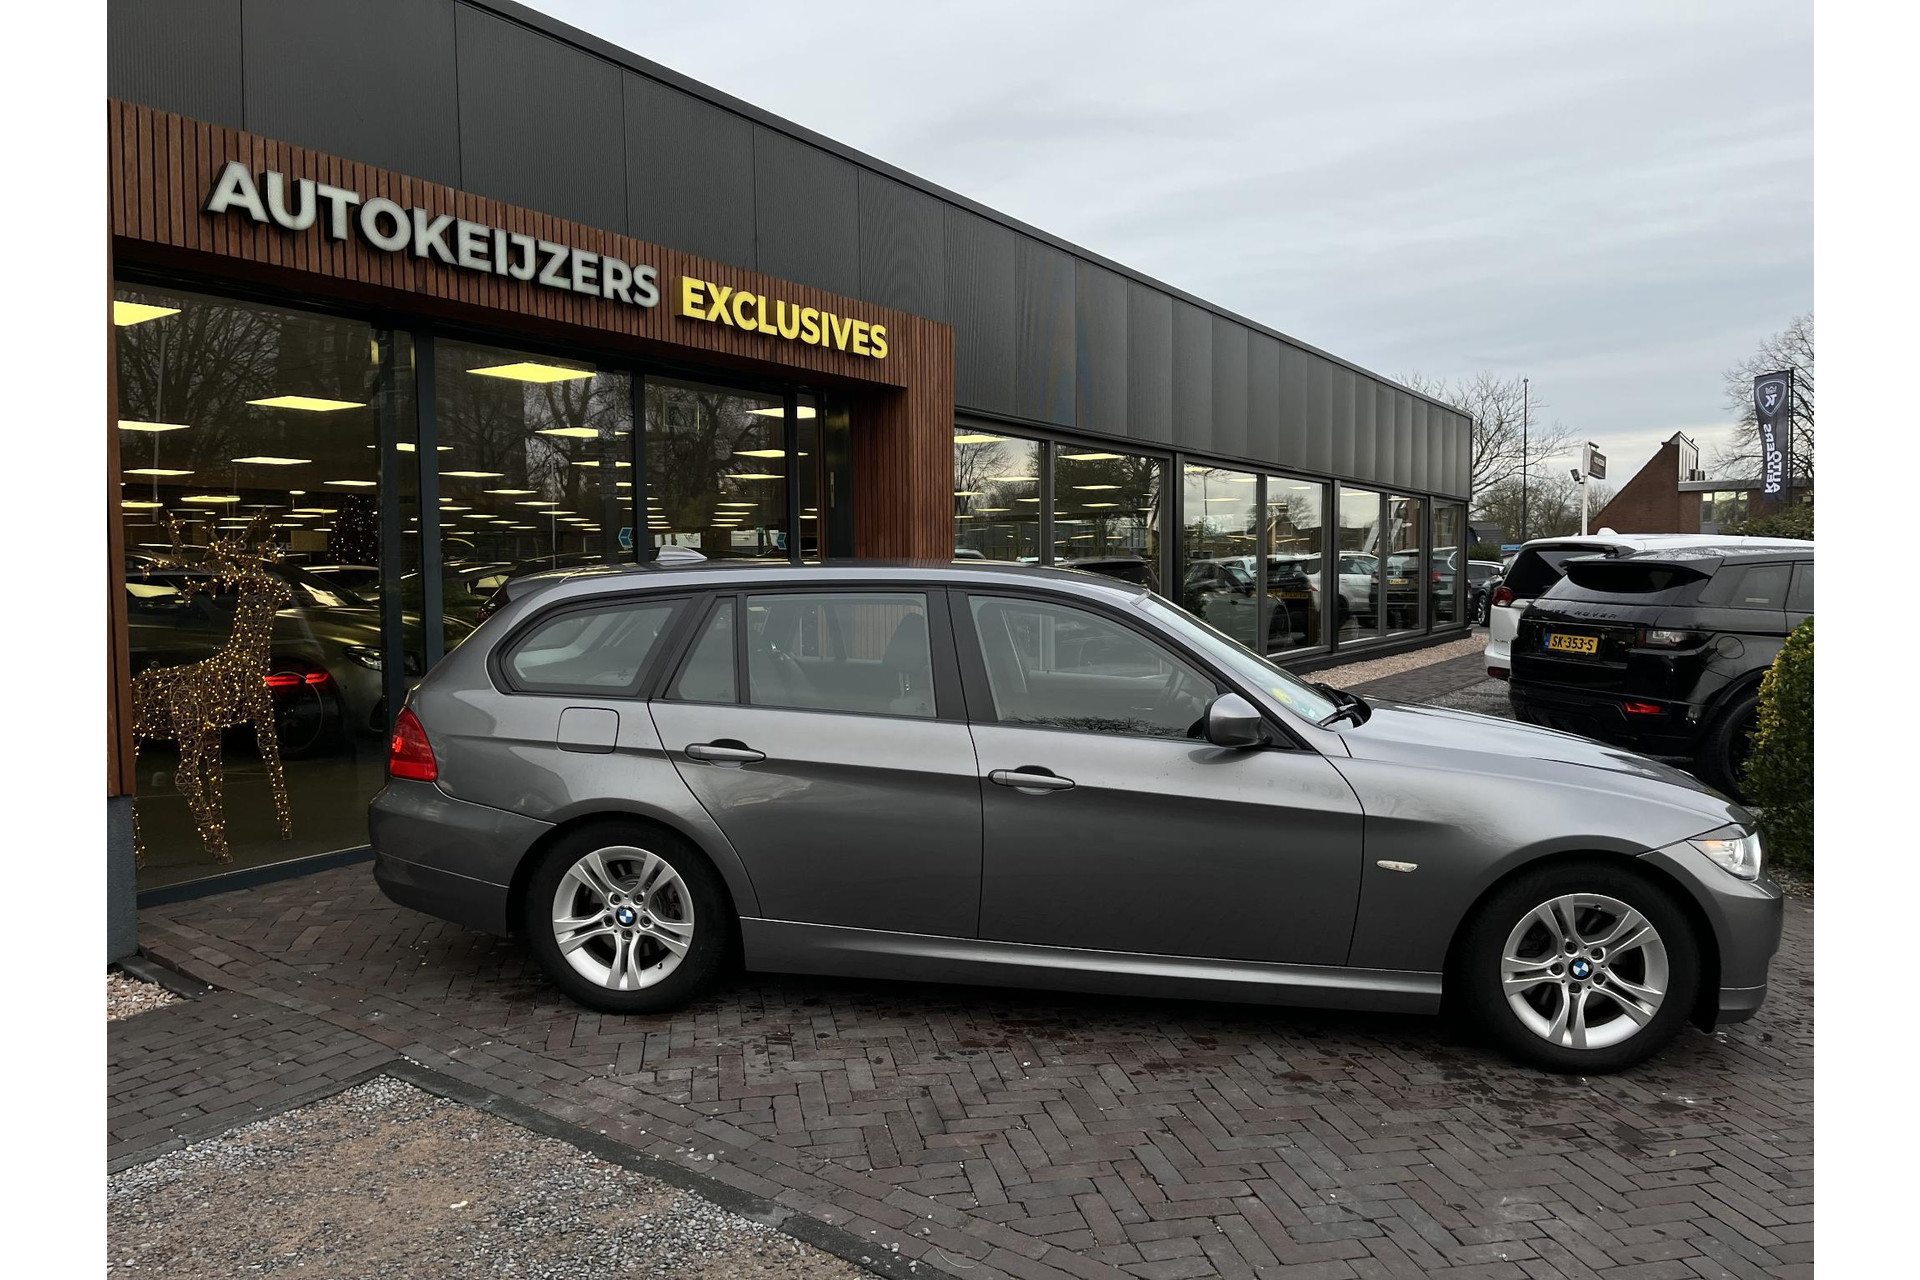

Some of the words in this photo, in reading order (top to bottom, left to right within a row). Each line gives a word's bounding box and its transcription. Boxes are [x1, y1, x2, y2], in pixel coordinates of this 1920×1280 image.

[205, 160, 660, 308] AUTOKEIJZERS
[681, 275, 889, 359] EXCLUSIVES
[1552, 635, 1594, 651] SK-353-S
